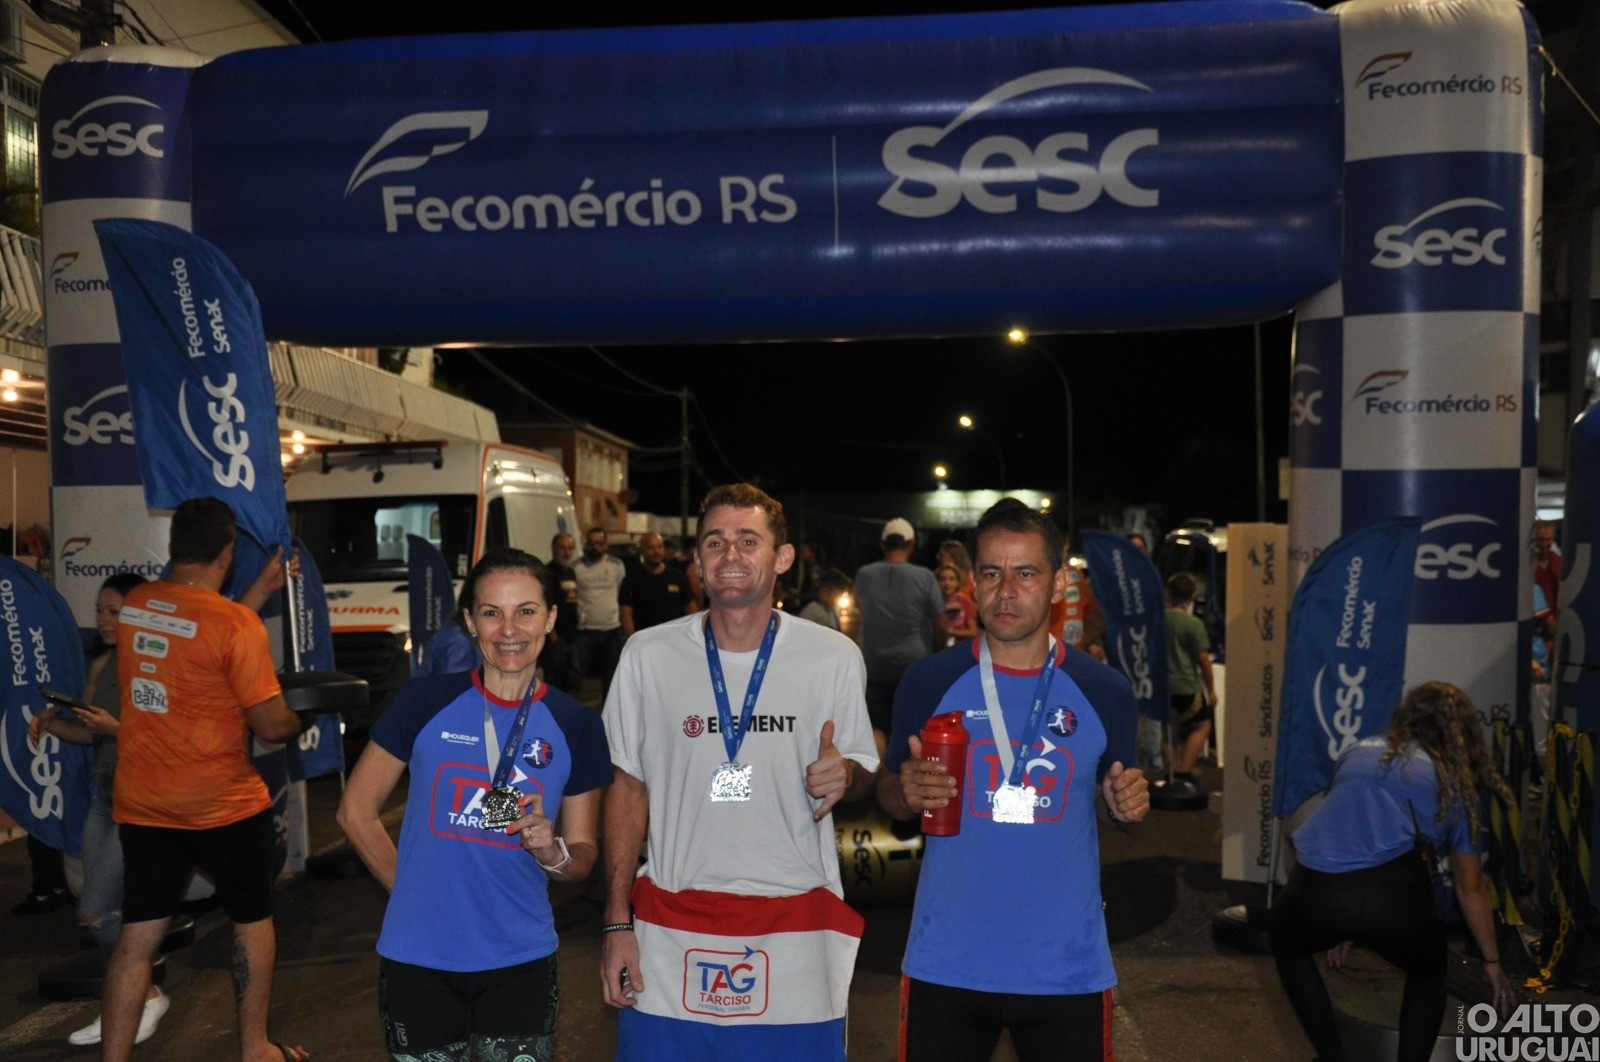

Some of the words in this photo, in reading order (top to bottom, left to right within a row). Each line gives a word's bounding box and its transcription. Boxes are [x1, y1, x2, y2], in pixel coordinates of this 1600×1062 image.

[1368, 74, 1495, 100] Fecomércio
[1501, 76, 1523, 96] RS
[382, 178, 702, 232] Fecomércio
[720, 174, 797, 223] RS
[171, 257, 206, 358] Fecomércio
[1366, 394, 1490, 414] Fecomércio
[1496, 395, 1516, 413] RS
[65, 560, 165, 577] Fecomércio
[1413, 542, 1502, 580] esc
[1336, 555, 1364, 649] Fecomércio
[0, 579, 28, 687] Fecomércio
[1259, 663, 1274, 738] Sindicatos
[1257, 783, 1271, 867] Fecomércio
[696, 961, 756, 993] TAG
[699, 992, 751, 1006] TARCISO
